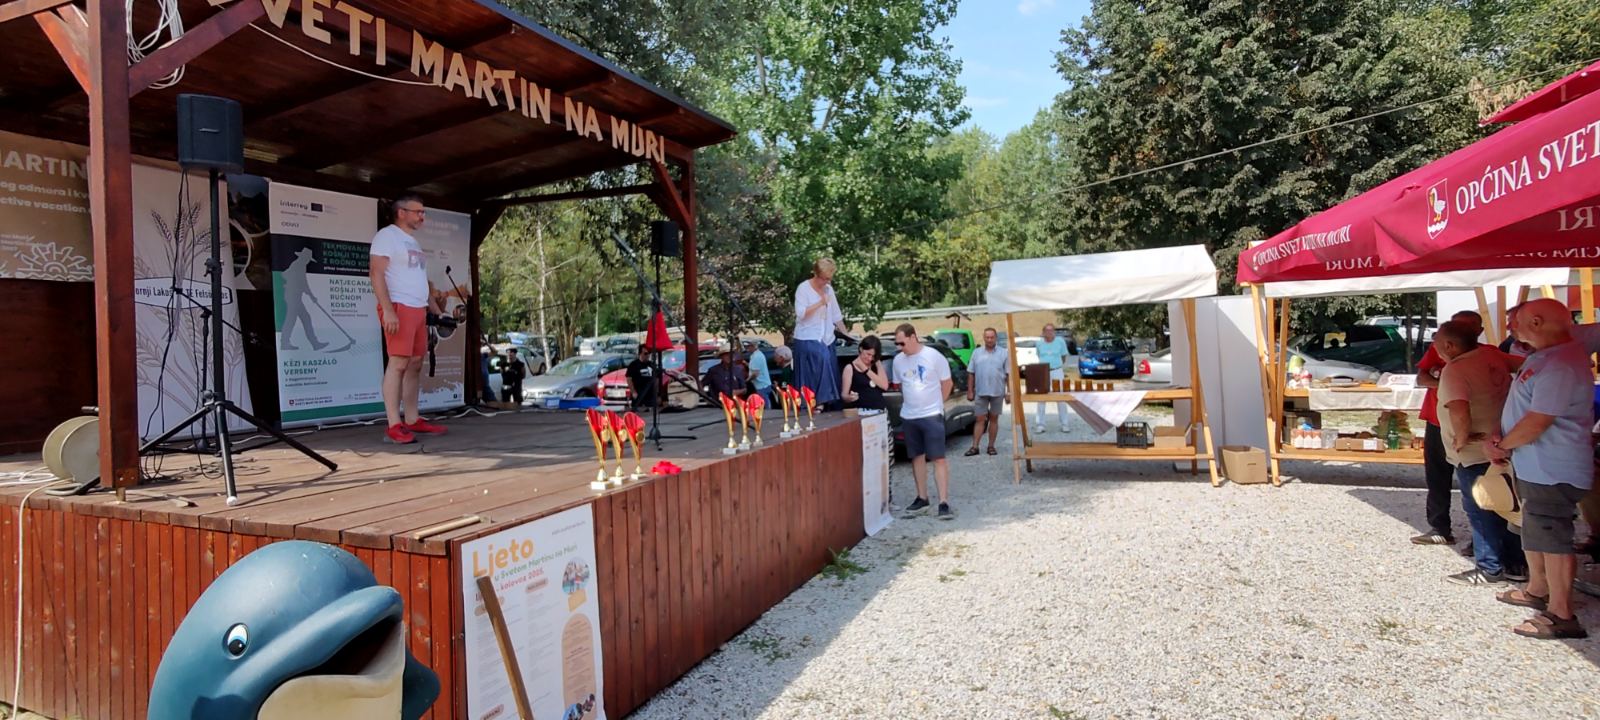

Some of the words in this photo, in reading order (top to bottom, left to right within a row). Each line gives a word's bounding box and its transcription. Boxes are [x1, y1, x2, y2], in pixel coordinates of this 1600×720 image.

[207, 0, 386, 66] VETI
[410, 29, 551, 124] MARTIN
[564, 96, 603, 141] NA
[610, 115, 666, 165] MURI
[0, 150, 87, 179] ARTIN
[1455, 156, 1533, 214] OPĆINA
[1538, 120, 1600, 180] SVET
[0, 181, 16, 192] og
[18, 182, 66, 196] odmora
[73, 189, 91, 199] kv
[0, 196, 32, 207] ctive
[33, 200, 87, 213] vacation
[329, 279, 372, 287] NATJECANJ
[135, 286, 151, 298] ornji
[283, 359, 301, 367] KÉZI
[284, 367, 318, 375] VERSENY
[472, 538, 534, 578] Ljeto
[501, 563, 528, 578] Svetom
